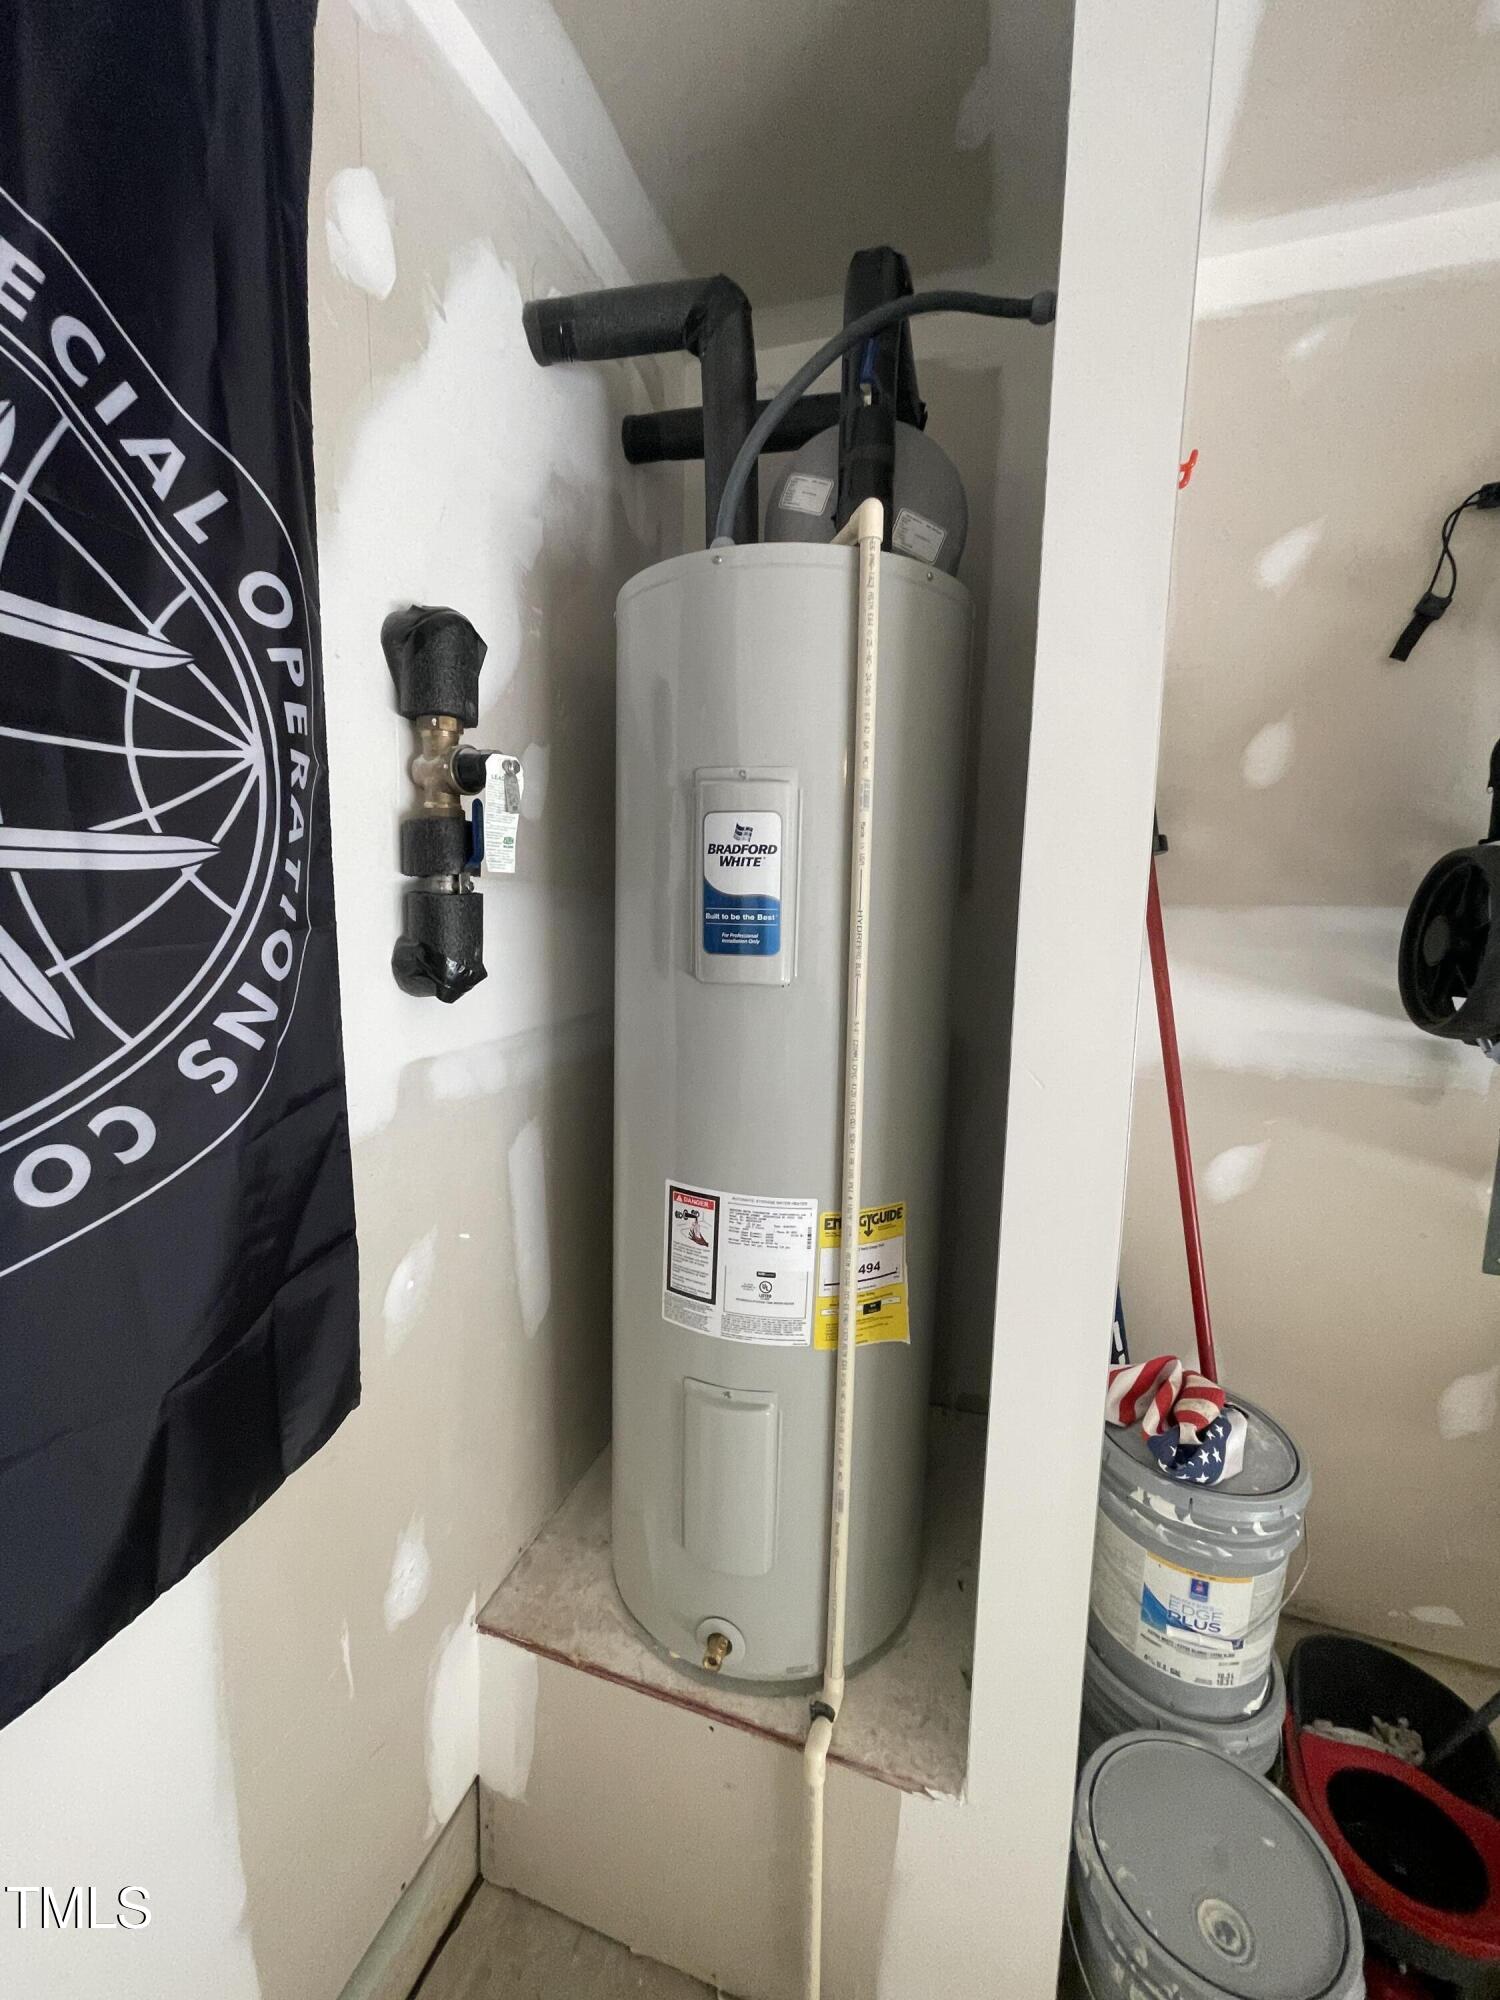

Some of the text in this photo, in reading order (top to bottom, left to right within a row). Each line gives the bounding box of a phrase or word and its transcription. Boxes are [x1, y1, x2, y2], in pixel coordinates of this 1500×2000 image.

[0, 236, 228, 545] ECIAL
[177, 570, 311, 1095] OPERATIONS
[708, 844, 777, 854] BRADFORD
[720, 856, 762, 866] WHITE
[684, 1196, 708, 1206] DANGER
[824, 1207, 903, 1231] ENGYGUIDE
[858, 1261, 880, 1274] 494
[1168, 1599, 1224, 1621] EDGE
[1168, 1610, 1220, 1633] PLUS
